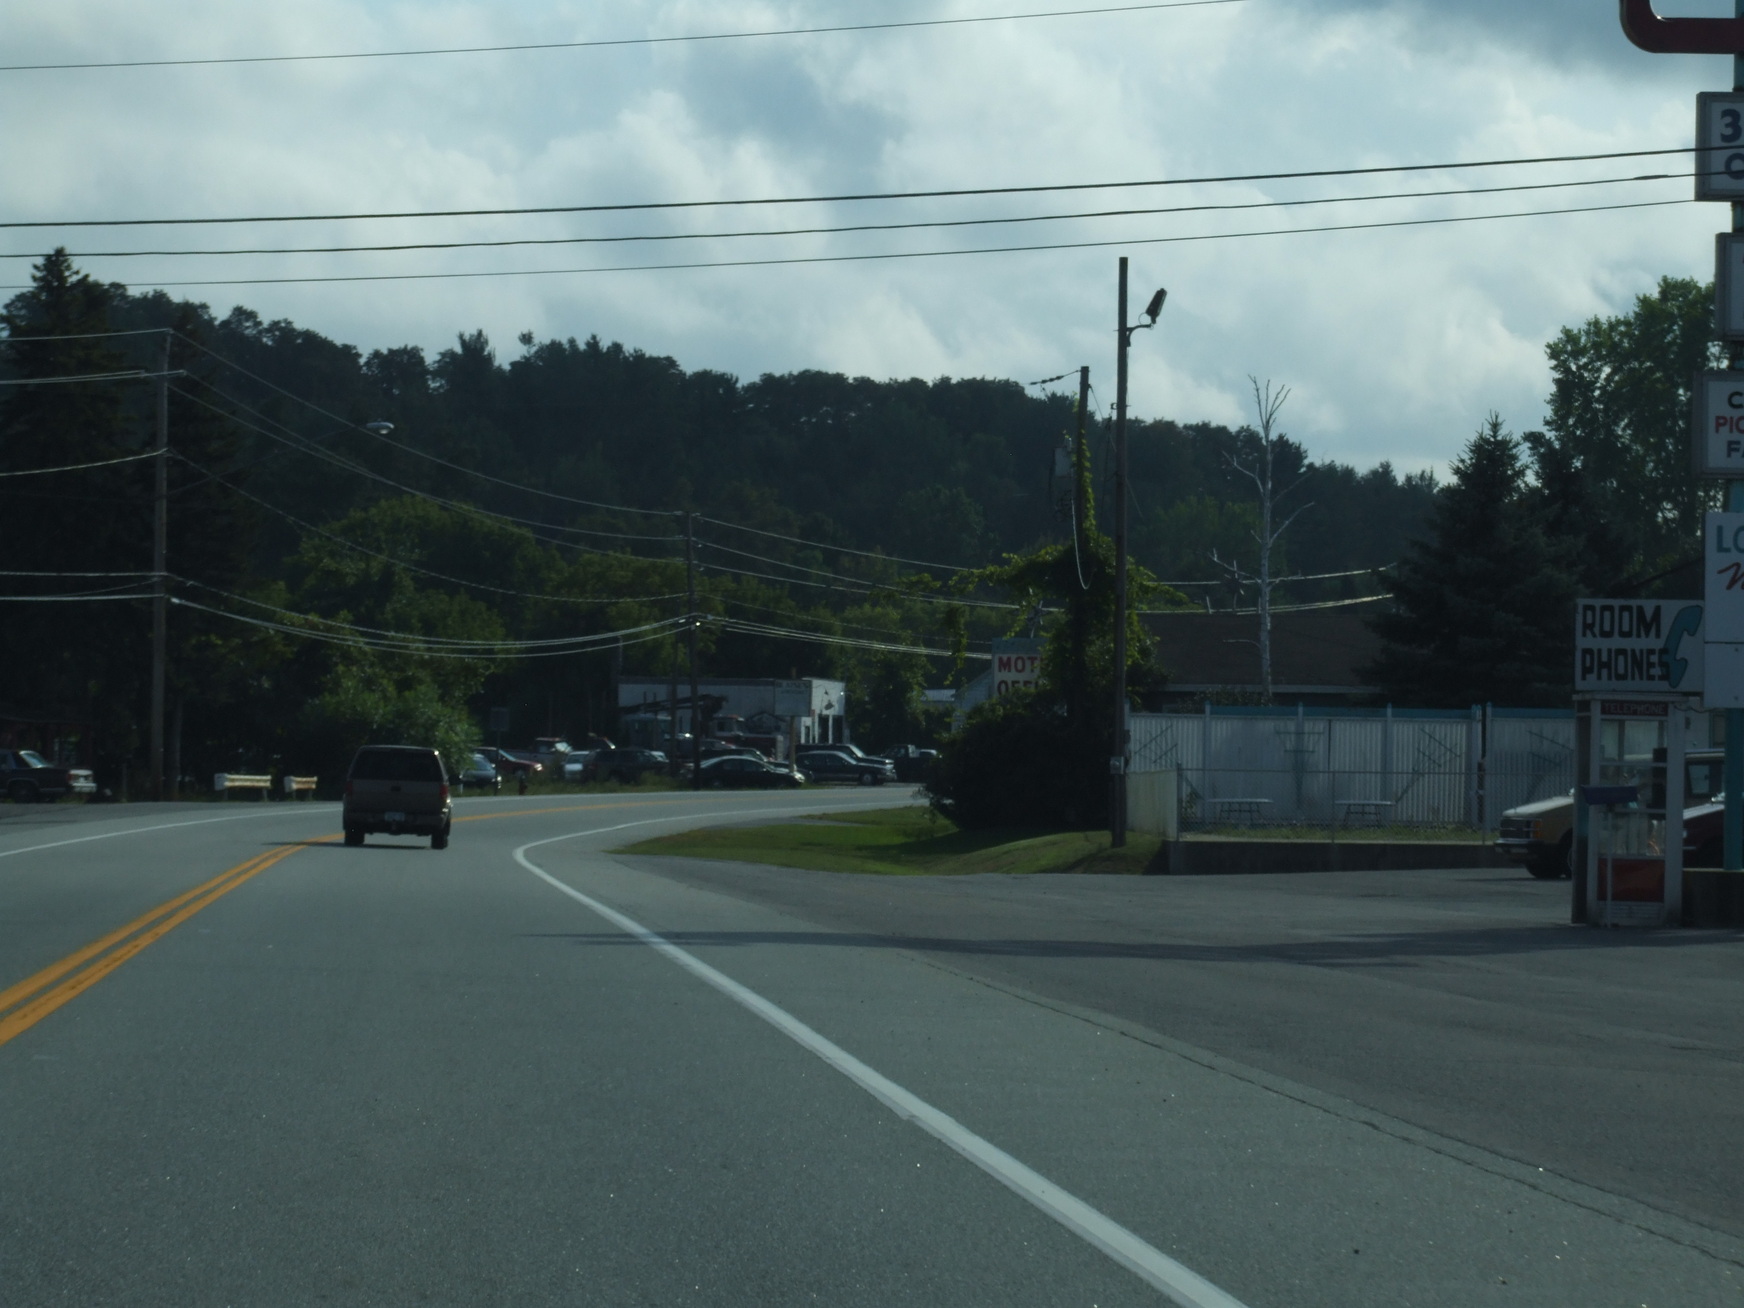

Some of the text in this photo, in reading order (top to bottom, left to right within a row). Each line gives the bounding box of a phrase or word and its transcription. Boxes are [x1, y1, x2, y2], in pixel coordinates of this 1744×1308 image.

[1727, 440, 1744, 458] F
[1582, 605, 1661, 639] ROOM
[998, 655, 1049, 673] MOT
[1581, 648, 1670, 681] PHONES
[1603, 703, 1666, 715] TELEPHONE
